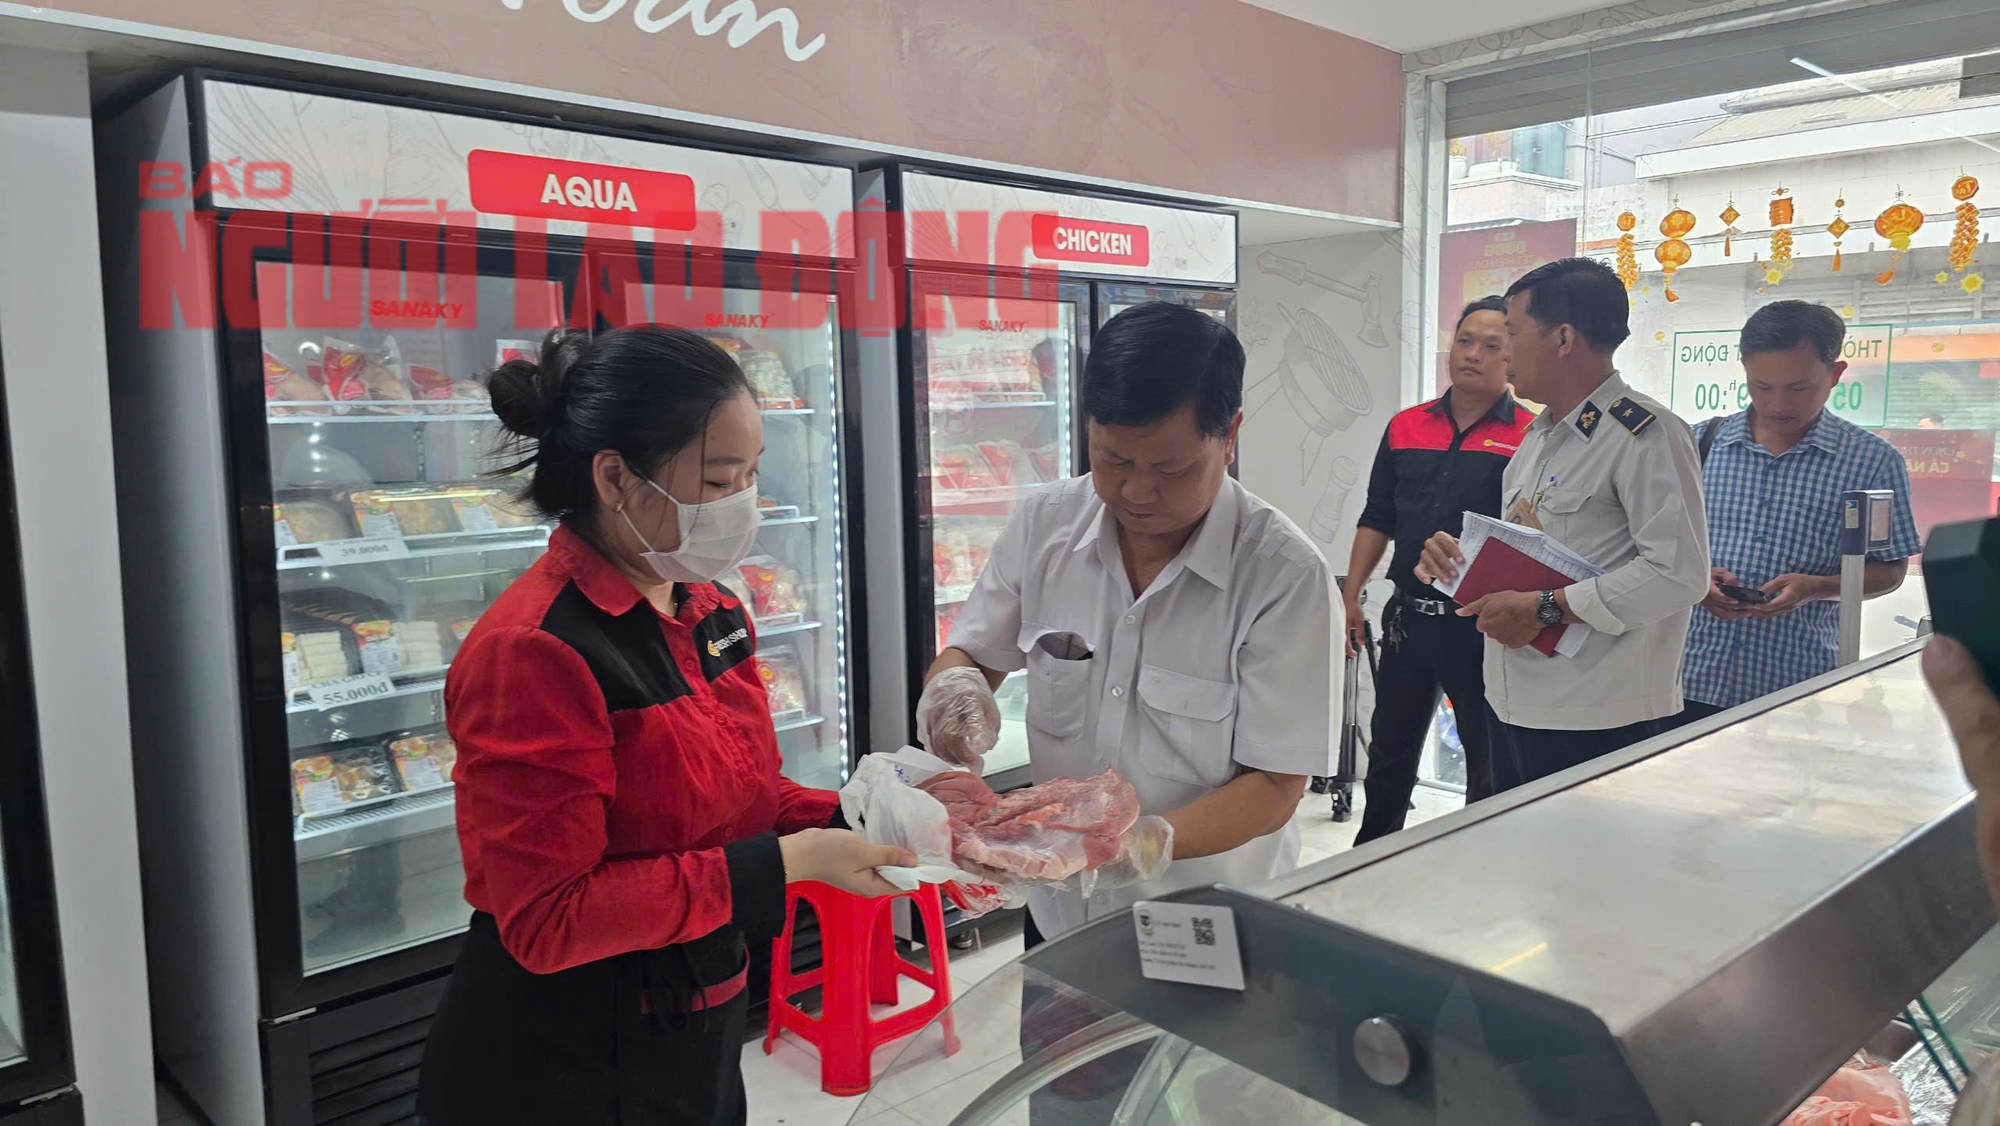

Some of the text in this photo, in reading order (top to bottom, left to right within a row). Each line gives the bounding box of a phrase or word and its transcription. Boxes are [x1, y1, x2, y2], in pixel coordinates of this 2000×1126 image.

[540, 173, 639, 213] AQUA
[1052, 226, 1132, 256] CHICKEN
[370, 300, 464, 319] SANAKY
[704, 313, 770, 329] SANAKY
[978, 319, 1026, 333] SANAKY
